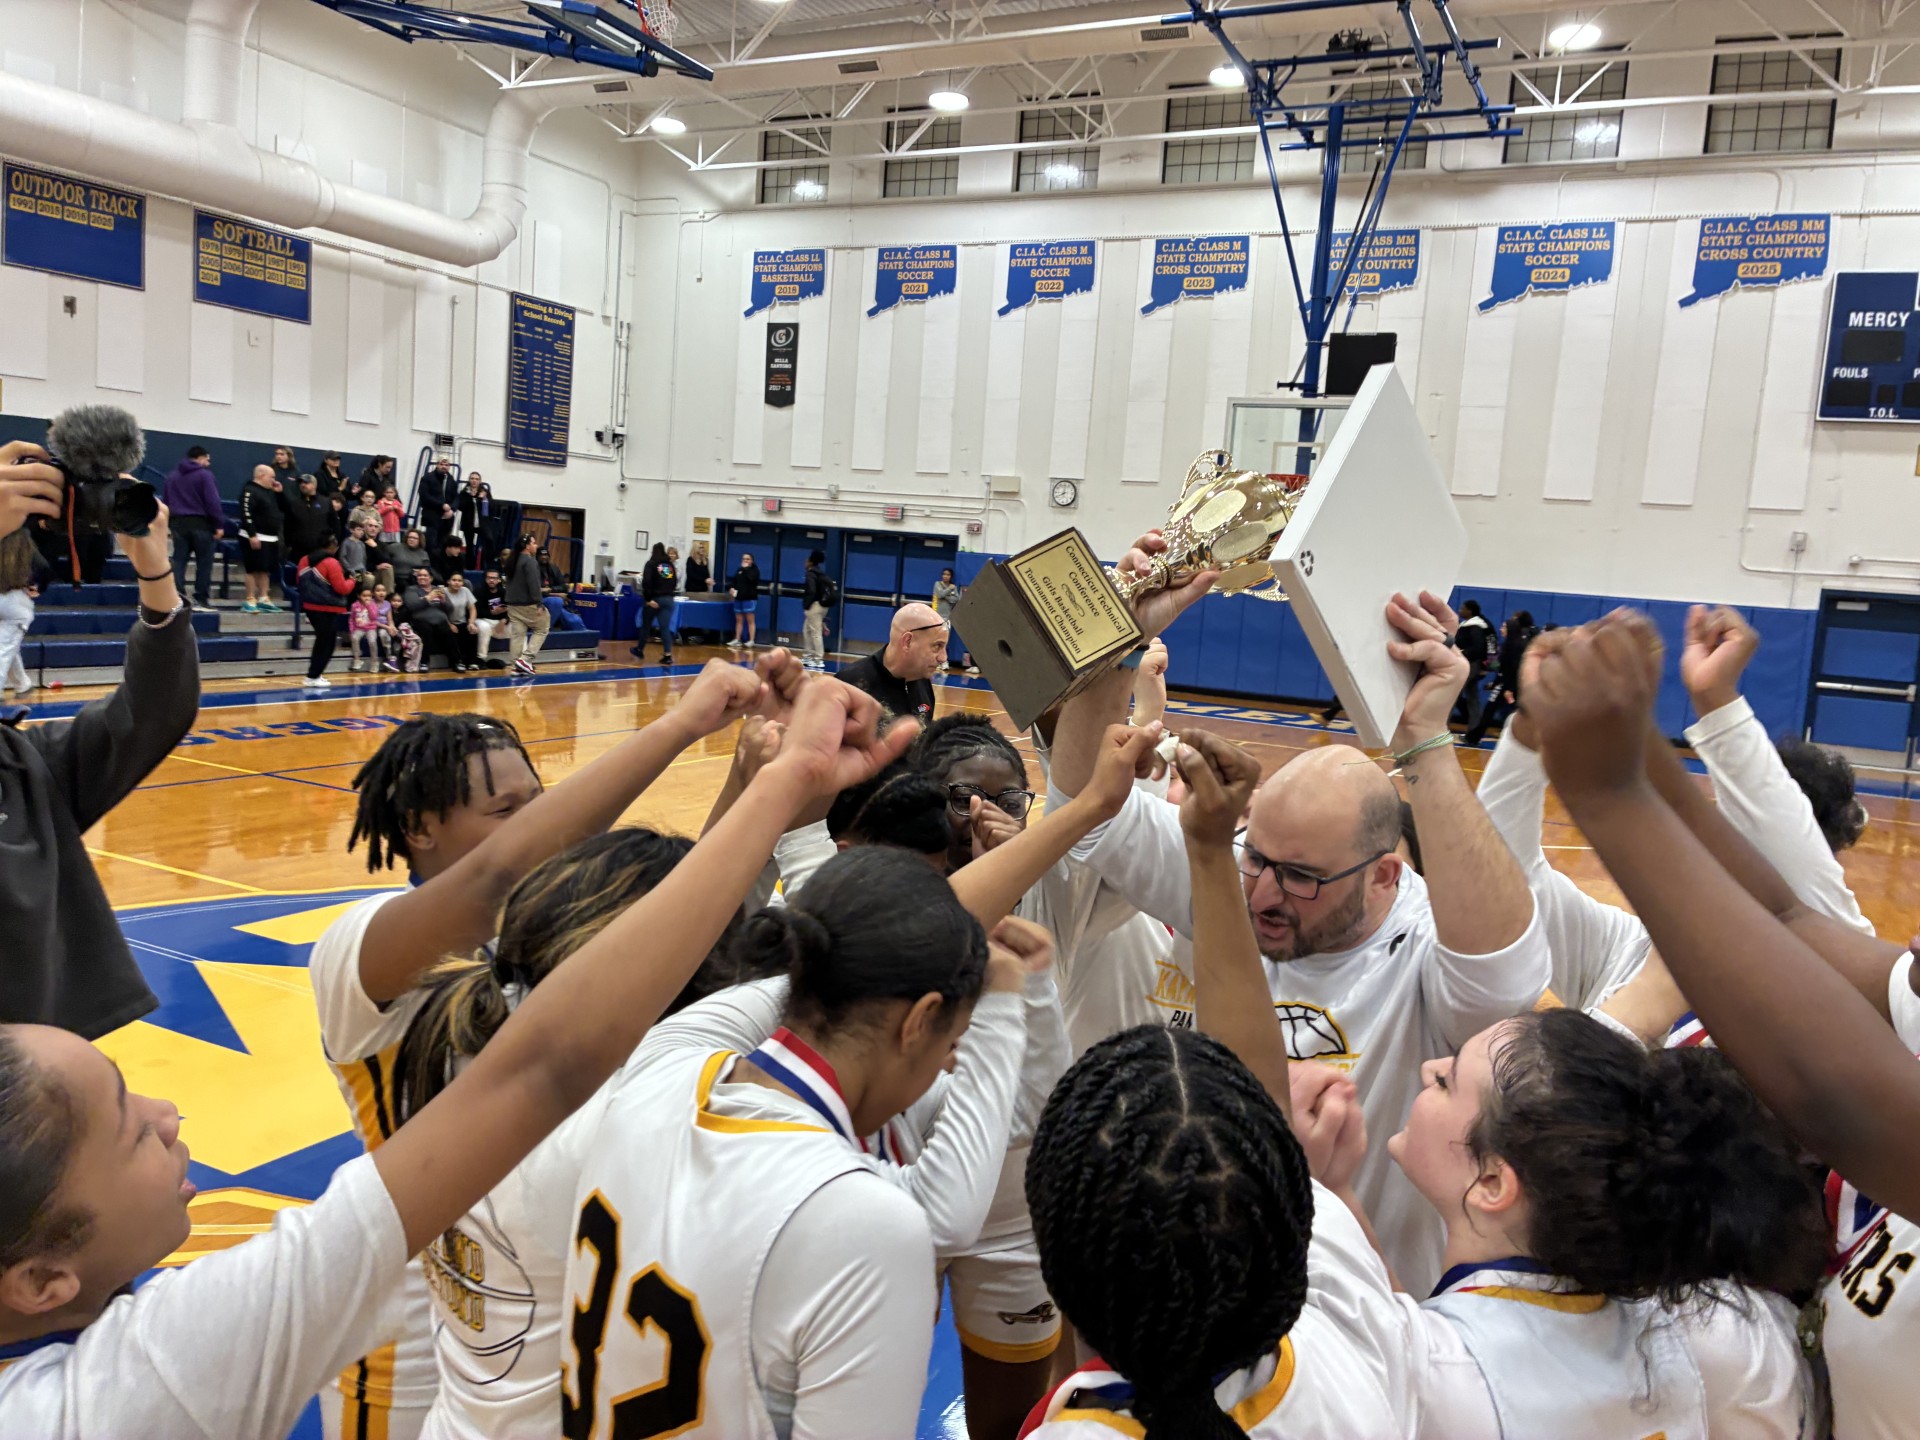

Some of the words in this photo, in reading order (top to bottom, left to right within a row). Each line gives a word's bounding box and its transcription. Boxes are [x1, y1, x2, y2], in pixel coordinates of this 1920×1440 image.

[11, 171, 85, 207] OUTDOOR
[89, 188, 138, 218] TRACK
[1703, 221, 1750, 234] C.I.A.C.
[1755, 220, 1798, 232] CLASS
[1801, 219, 1825, 231] MM
[213, 220, 295, 257] SOFTBALL
[1396, 235, 1416, 245] MM
[1504, 230, 1545, 242] C.I.A.C.
[1550, 229, 1589, 240] CLASS
[1591, 227, 1607, 239] LL
[1701, 235, 1742, 247] STATE
[1746, 233, 1825, 245] CHAMPIONS
[1015, 247, 1046, 257] C.I.A.C.
[1049, 246, 1077, 256] CLASS
[1080, 245, 1088, 255] M
[1162, 242, 1195, 252] C.I.A.C.
[1199, 241, 1230, 251] CLASS
[1232, 240, 1241, 250] M
[1358, 246, 1416, 258] HAMPIONS
[1498, 242, 1535, 254] STATE
[1538, 240, 1611, 252] CHAMPIONS
[757, 254, 784, 263] C.I.A.C.
[786, 254, 809, 263] CLASS
[811, 253, 820, 262] LL
[883, 251, 912, 260] C.I.A.C.
[914, 250, 940, 260] CLASS
[942, 249, 950, 259] M
[1156, 252, 1186, 263] STATE
[1188, 251, 1246, 262] CHAMPIONS
[1700, 249, 1748, 261] CROSS
[1753, 246, 1825, 259] COUNTRY
[878, 261, 903, 270] STATE
[904, 260, 954, 270] CHAMPIONS
[1010, 257, 1037, 267] STATE
[1039, 256, 1092, 266] CHAMPIONS
[1357, 258, 1415, 270] COUNTRY
[1525, 254, 1580, 266] SOCCER
[754, 263, 777, 273] STATE
[779, 263, 823, 272] CHAMPIONS
[1030, 268, 1071, 278] SOCCER
[1155, 264, 1191, 275] CROSS
[1193, 263, 1245, 274] COUNTRY
[1741, 264, 1778, 275] 2025
[761, 273, 814, 283] BASKETBALL
[897, 271, 934, 280] SOCCER
[1348, 275, 1377, 285] 2024
[1534, 270, 1568, 281] 2024
[904, 284, 926, 293] 2021
[1037, 281, 1062, 291] 2022
[1185, 278, 1212, 288] 2023
[777, 286, 797, 295] 2018
[516, 298, 547, 314] Swimming
[554, 308, 573, 321] Diving
[523, 309, 543, 321] School
[544, 314, 566, 326] Records
[1848, 311, 1911, 328] MERCY
[1832, 367, 1869, 379] FOULS
[1868, 407, 1899, 419] T.O.L.
[1065, 545, 1099, 594] Connecticut
[1097, 593, 1126, 633] Technical
[1068, 571, 1100, 618] Conference
[1024, 567, 1056, 615] Tournament
[1054, 613, 1082, 654] Champion
[1042, 576, 1057, 596] Girls
[1055, 594, 1085, 636] Basketball
